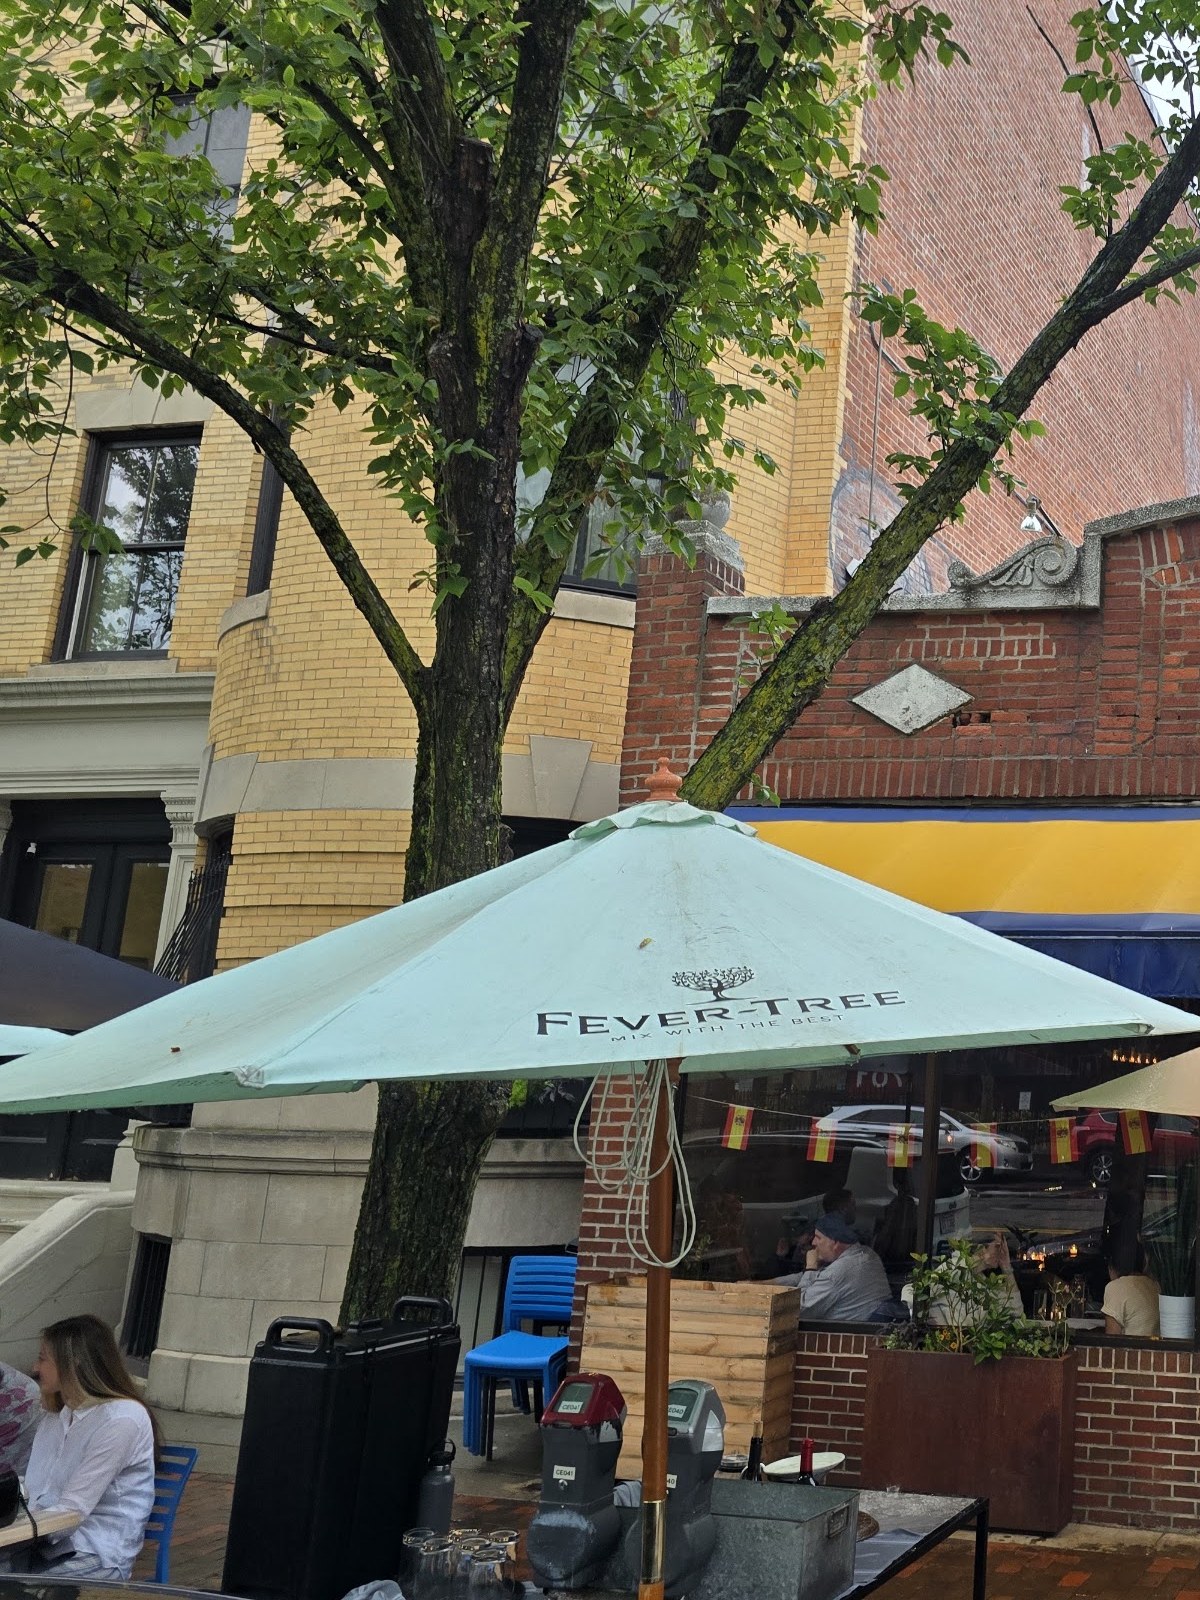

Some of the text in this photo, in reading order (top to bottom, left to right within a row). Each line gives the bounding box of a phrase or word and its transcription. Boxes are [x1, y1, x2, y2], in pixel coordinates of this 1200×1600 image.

[537, 990, 906, 1036] FEVER-TREE
[611, 1014, 843, 1042] MIX WITH THE BEST
